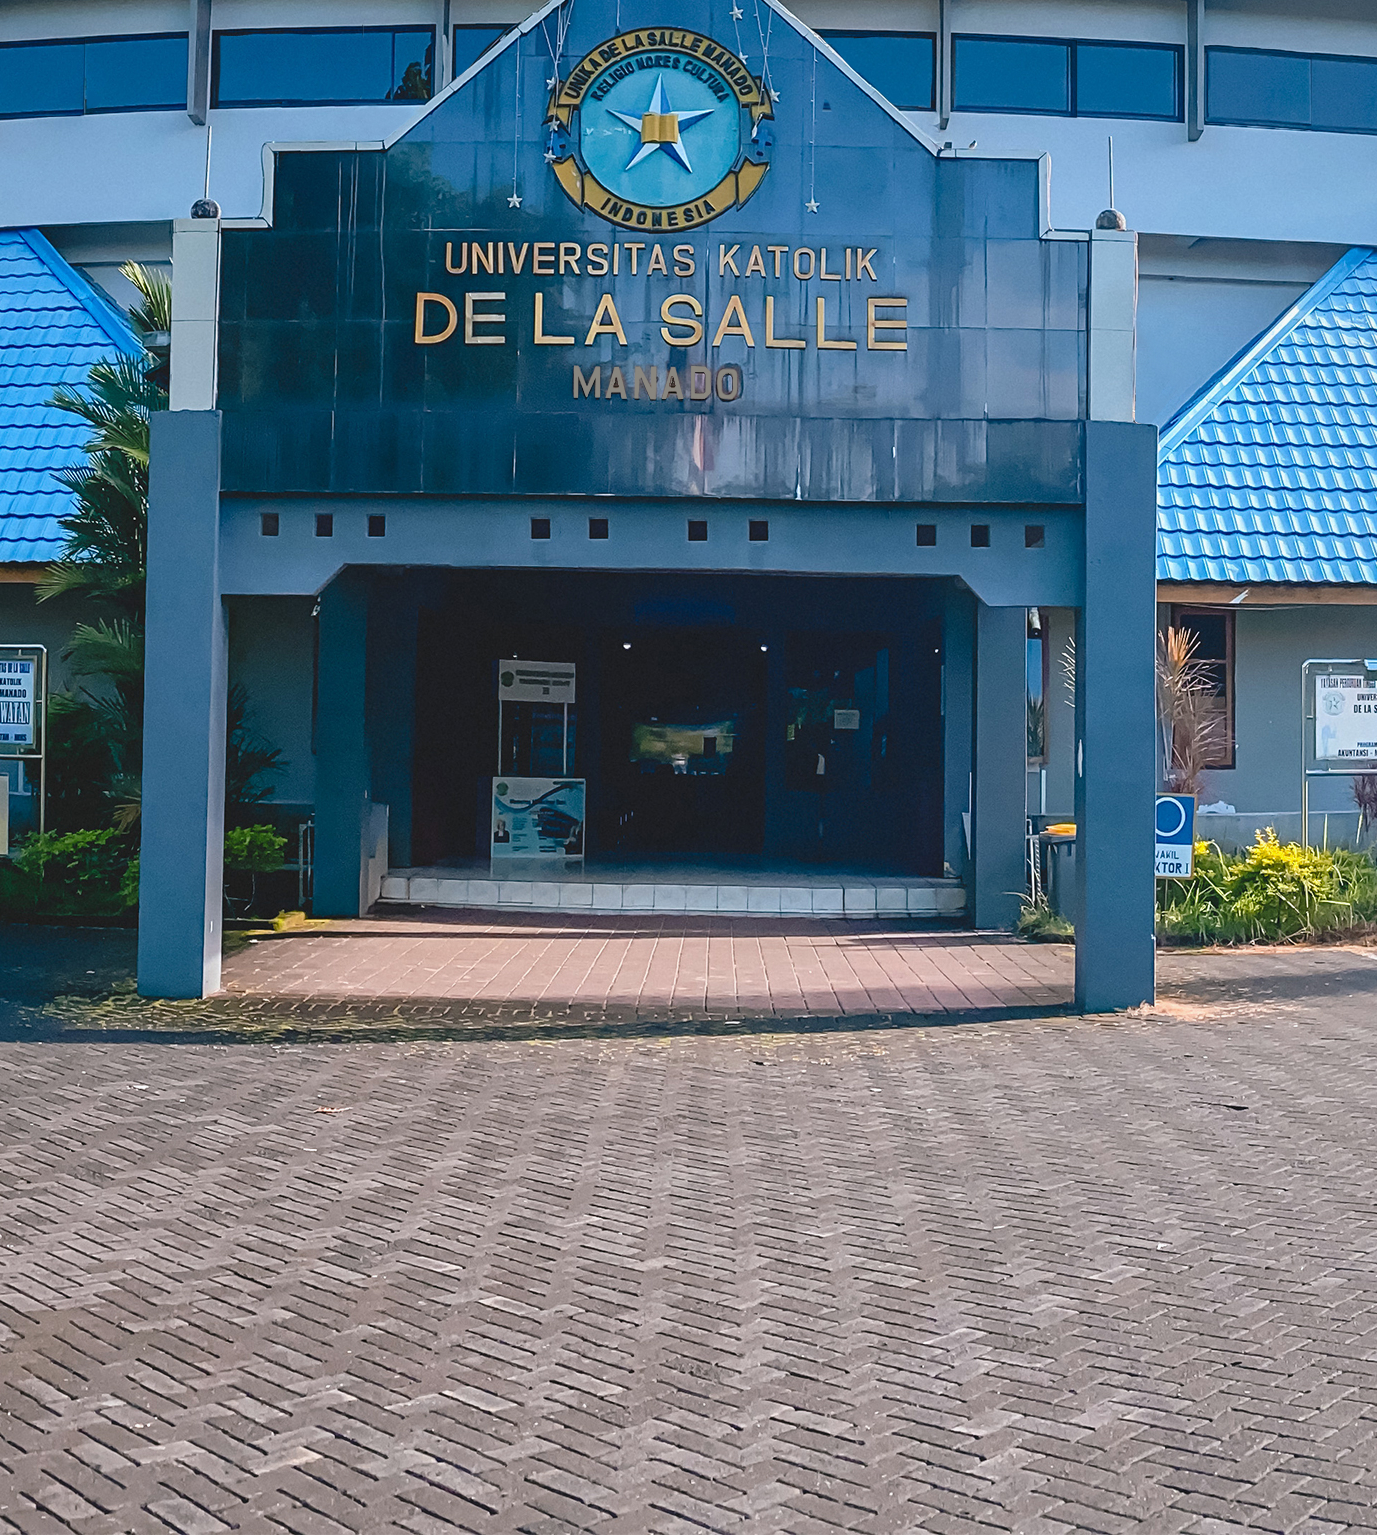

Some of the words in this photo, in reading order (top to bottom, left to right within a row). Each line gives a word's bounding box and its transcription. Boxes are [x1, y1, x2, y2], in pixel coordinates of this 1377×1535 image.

[564, 59, 602, 99] UNIKA
[598, 43, 622, 63] DE
[621, 34, 645, 51] LA
[647, 31, 702, 54] SALLE
[703, 43, 754, 97] MANADO
[590, 61, 635, 102] RELIGIO
[683, 59, 730, 103] CULTURA
[600, 197, 716, 227] INDONESIA
[445, 242, 696, 278] UNIVERSITAS
[719, 244, 878, 281] KATOLIK
[414, 292, 506, 345] DE
[533, 292, 628, 346] LA
[660, 293, 908, 351] SALLE
[573, 365, 740, 401] MANADO
[0, 689, 27, 698] MANADO
[1353, 705, 1361, 713] DE
[1364, 705, 1372, 713] LA
[1337, 749, 1369, 757] AKUNTANSI
[1156, 862, 1182, 874] KTOR
